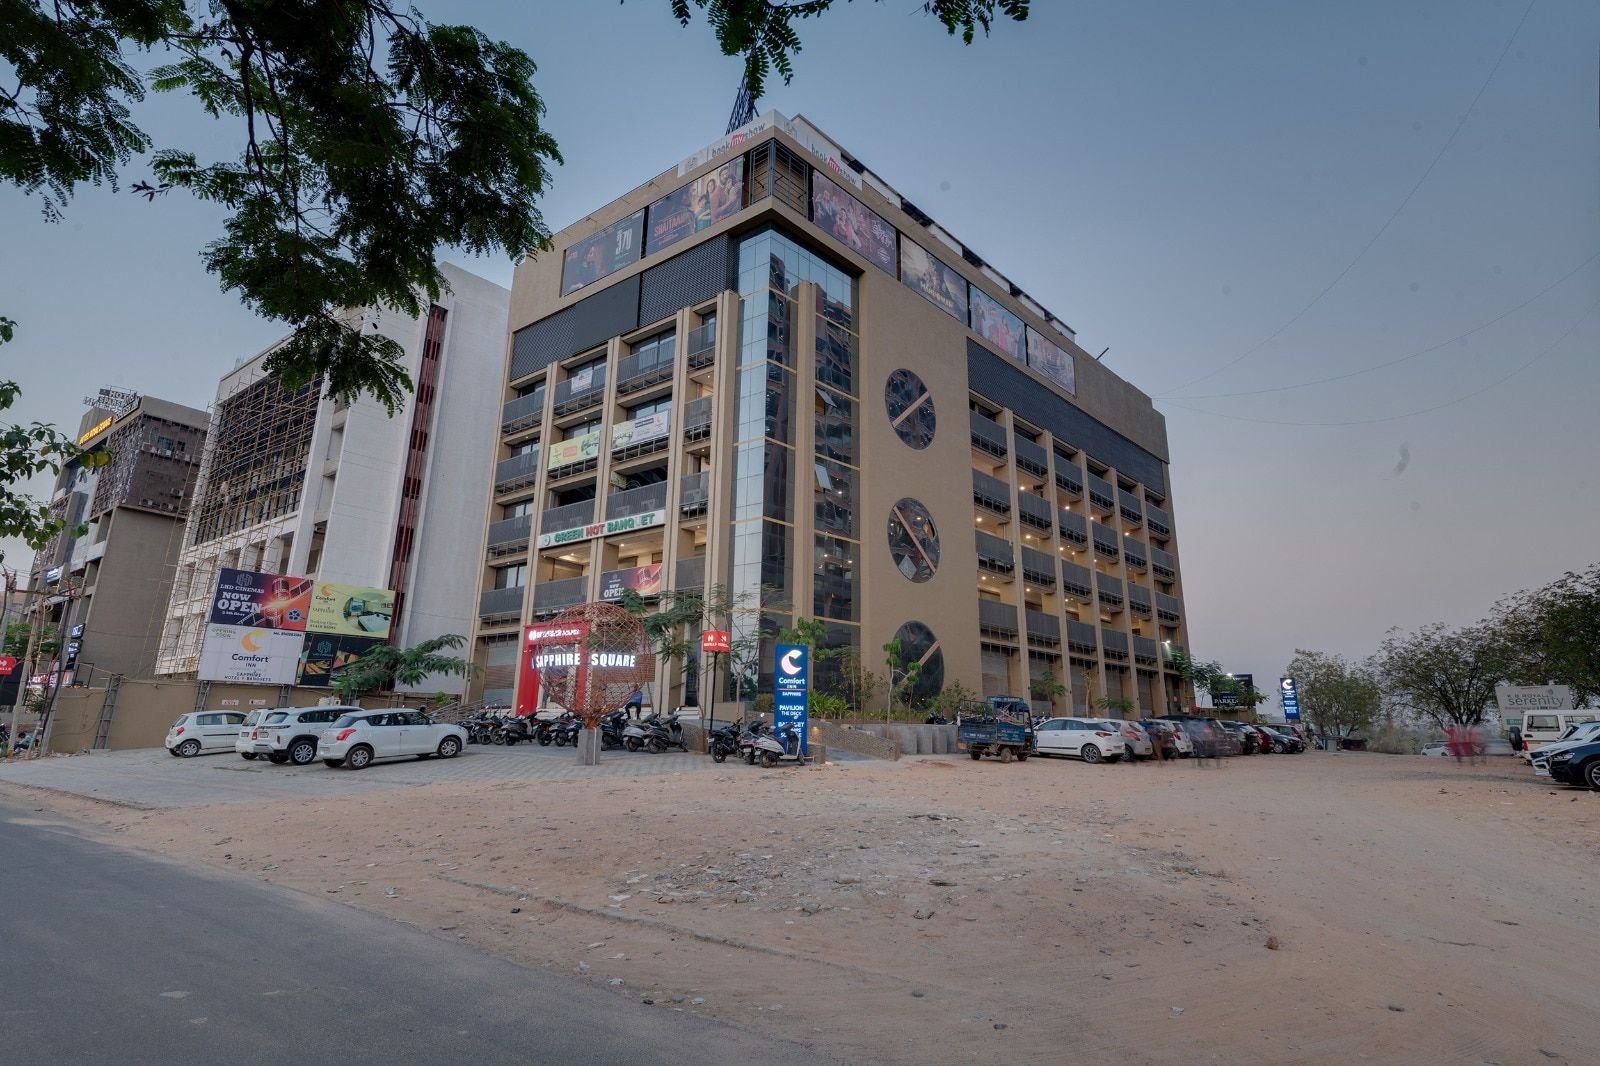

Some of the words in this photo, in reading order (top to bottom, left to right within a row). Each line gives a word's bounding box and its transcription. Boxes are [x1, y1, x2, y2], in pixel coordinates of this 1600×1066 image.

[553, 528, 584, 544] GREEN
[585, 523, 606, 537] HOT
[606, 512, 656, 533] BANQET
[222, 592, 251, 601] NOW
[217, 599, 263, 614] OPEN
[231, 653, 269, 663] Comfort
[535, 653, 581, 668] SAPPHIRE
[590, 653, 636, 668] SQUARE
[1508, 697, 1564, 707] serenity
